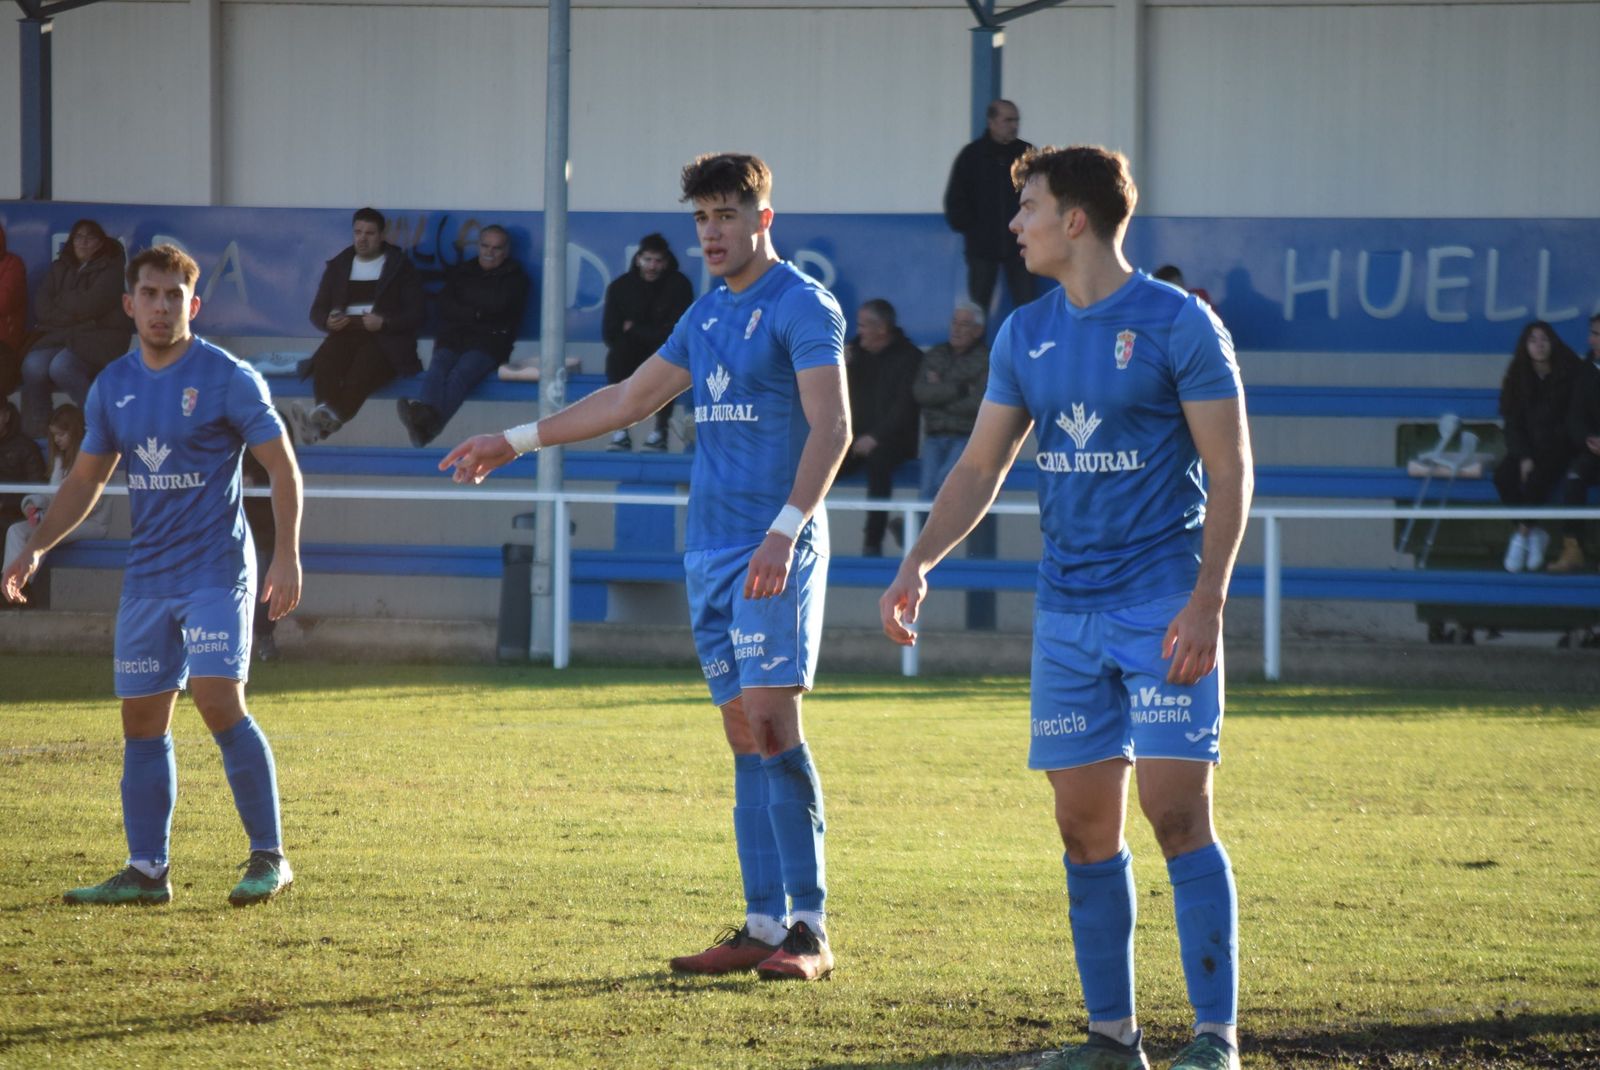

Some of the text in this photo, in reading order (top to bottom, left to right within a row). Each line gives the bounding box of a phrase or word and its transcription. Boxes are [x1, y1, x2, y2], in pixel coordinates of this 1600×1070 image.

[1283, 247, 1600, 323] HUELL
[709, 404, 759, 422] RURAL
[1036, 450, 1145, 473] CAJA RURAL
[149, 472, 206, 490] RURAL
[189, 626, 229, 642] Viso
[730, 627, 766, 646] Viso
[1139, 686, 1192, 707] Viso
